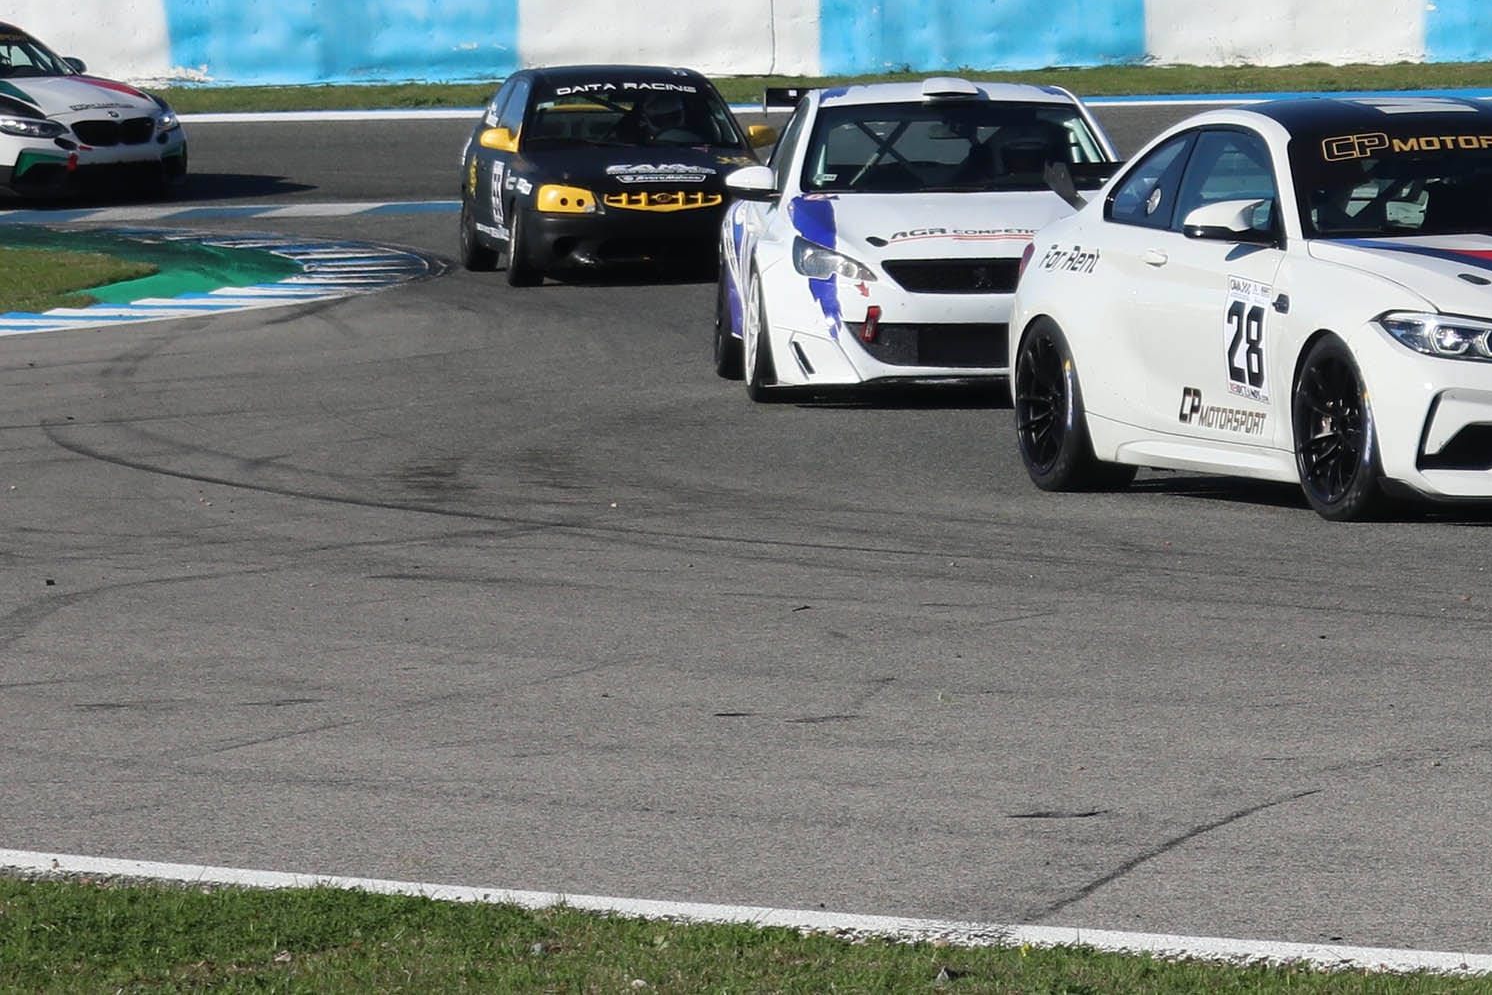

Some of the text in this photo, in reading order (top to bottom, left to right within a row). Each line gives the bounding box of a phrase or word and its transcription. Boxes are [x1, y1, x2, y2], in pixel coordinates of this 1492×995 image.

[556, 82, 697, 95] DAITA RACING
[1321, 132, 1390, 161] CP
[890, 228, 947, 240] AGR
[1039, 244, 1100, 274] For Rent
[1227, 300, 1265, 389] 28
[1179, 386, 1202, 423] CP
[1199, 405, 1267, 435] MOTORSPORT
